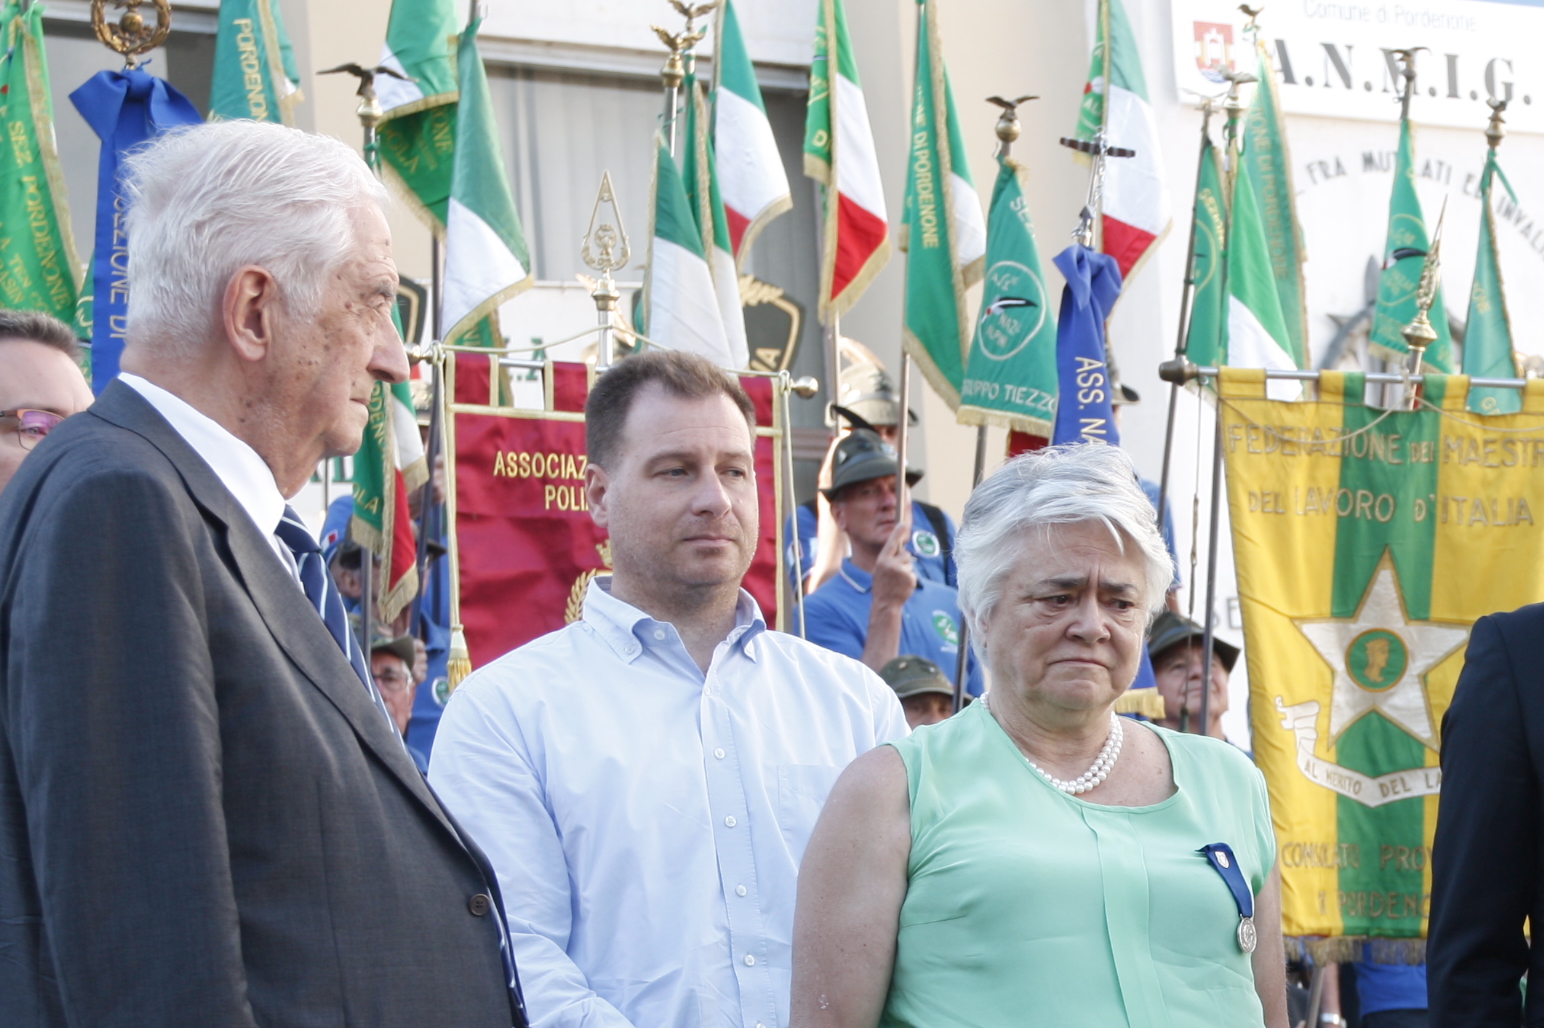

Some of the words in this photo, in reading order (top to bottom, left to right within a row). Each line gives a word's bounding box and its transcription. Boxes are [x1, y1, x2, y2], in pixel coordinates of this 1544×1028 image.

[1304, 0, 1371, 23] Comune
[1377, 3, 1390, 24] di
[1395, 5, 1477, 34] Pordenone
[1306, 155, 1348, 186] FRA
[914, 149, 939, 249] PORDENONE
[22, 175, 73, 311] PORDENONE
[1262, 175, 1289, 281] PORDENONE
[1075, 356, 1105, 411] ASS.
[493, 450, 587, 479] ASSOCIAZ
[1228, 423, 1402, 465] FEDERAZIONE
[1410, 441, 1435, 463] DEI
[1248, 489, 1287, 514] DEL
[1293, 486, 1395, 523] LAVORO
[1303, 758, 1318, 779] AL
[1325, 768, 1362, 796] MERITO
[1378, 776, 1412, 798] DEL
